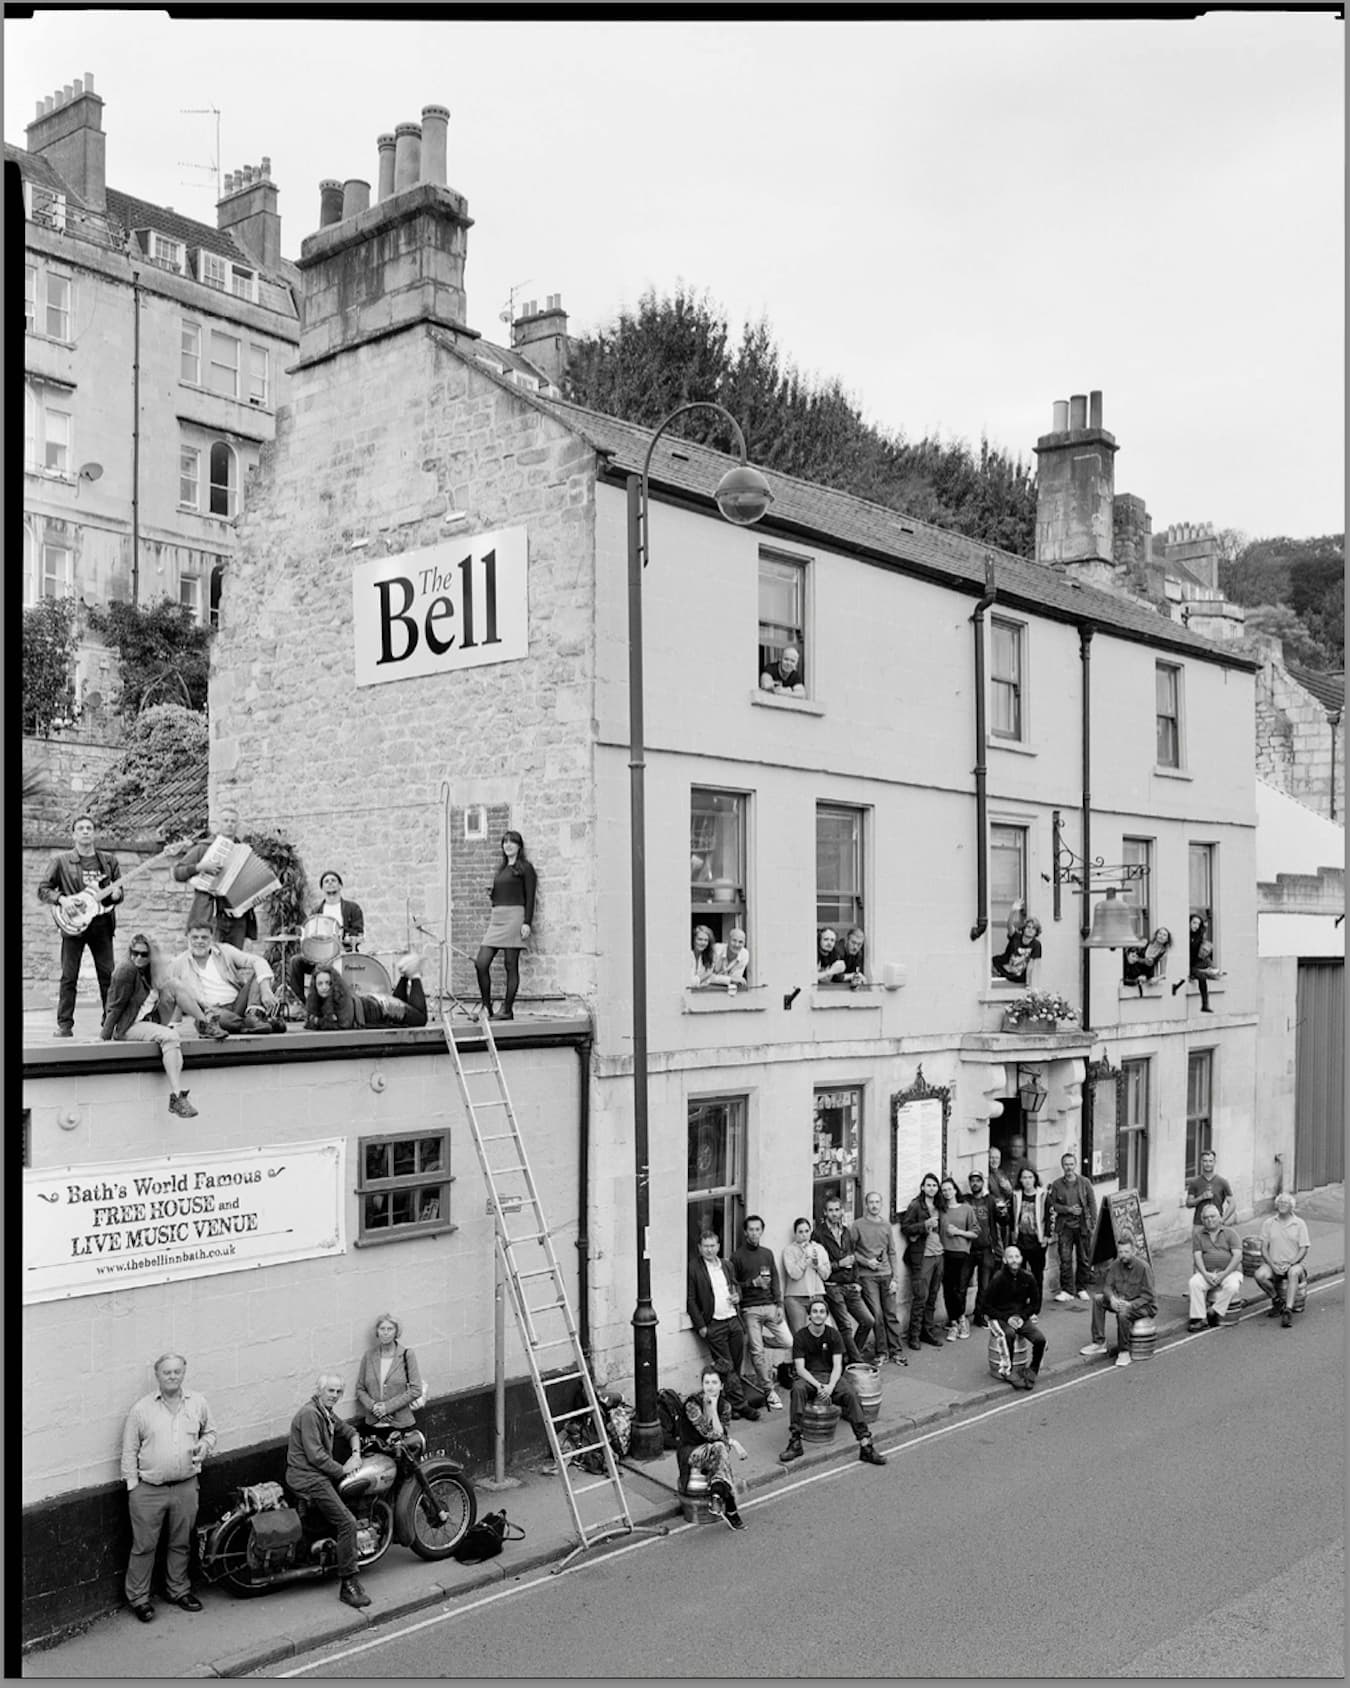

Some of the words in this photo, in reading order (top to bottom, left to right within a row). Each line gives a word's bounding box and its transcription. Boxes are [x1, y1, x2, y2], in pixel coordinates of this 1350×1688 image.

[419, 566, 453, 595] The
[373, 548, 502, 665] Bell
[67, 1182, 127, 1205] Bath's
[133, 1174, 188, 1196] World
[193, 1170, 262, 1190] Famous
[92, 1203, 146, 1227] FREE
[150, 1195, 215, 1220] HOUSE
[218, 1197, 240, 1211] and
[71, 1232, 122, 1257] LIVE
[126, 1222, 189, 1249] MUSIC
[193, 1213, 258, 1239] VENUE
[96, 1243, 236, 1275] www.thebellinnbath.co.uk
